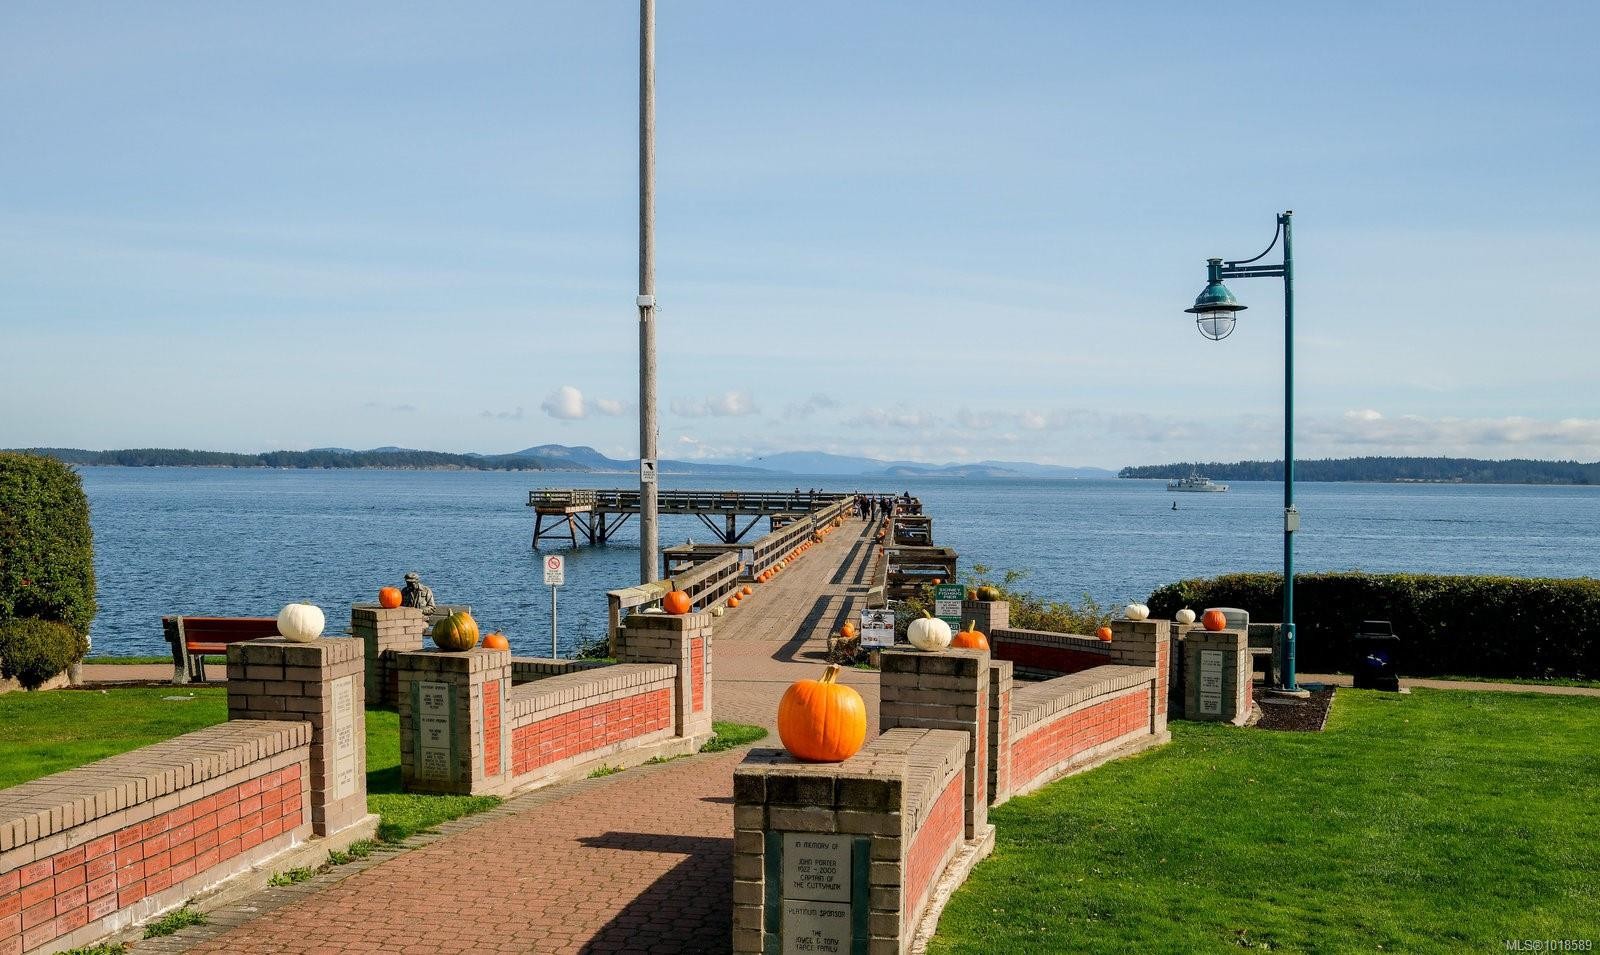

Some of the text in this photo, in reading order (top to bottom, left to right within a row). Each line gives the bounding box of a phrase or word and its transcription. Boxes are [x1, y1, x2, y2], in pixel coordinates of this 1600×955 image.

[803, 841, 830, 850] MEMORY
[793, 881, 804, 889] THE
[819, 909, 846, 918] SPONSOR
